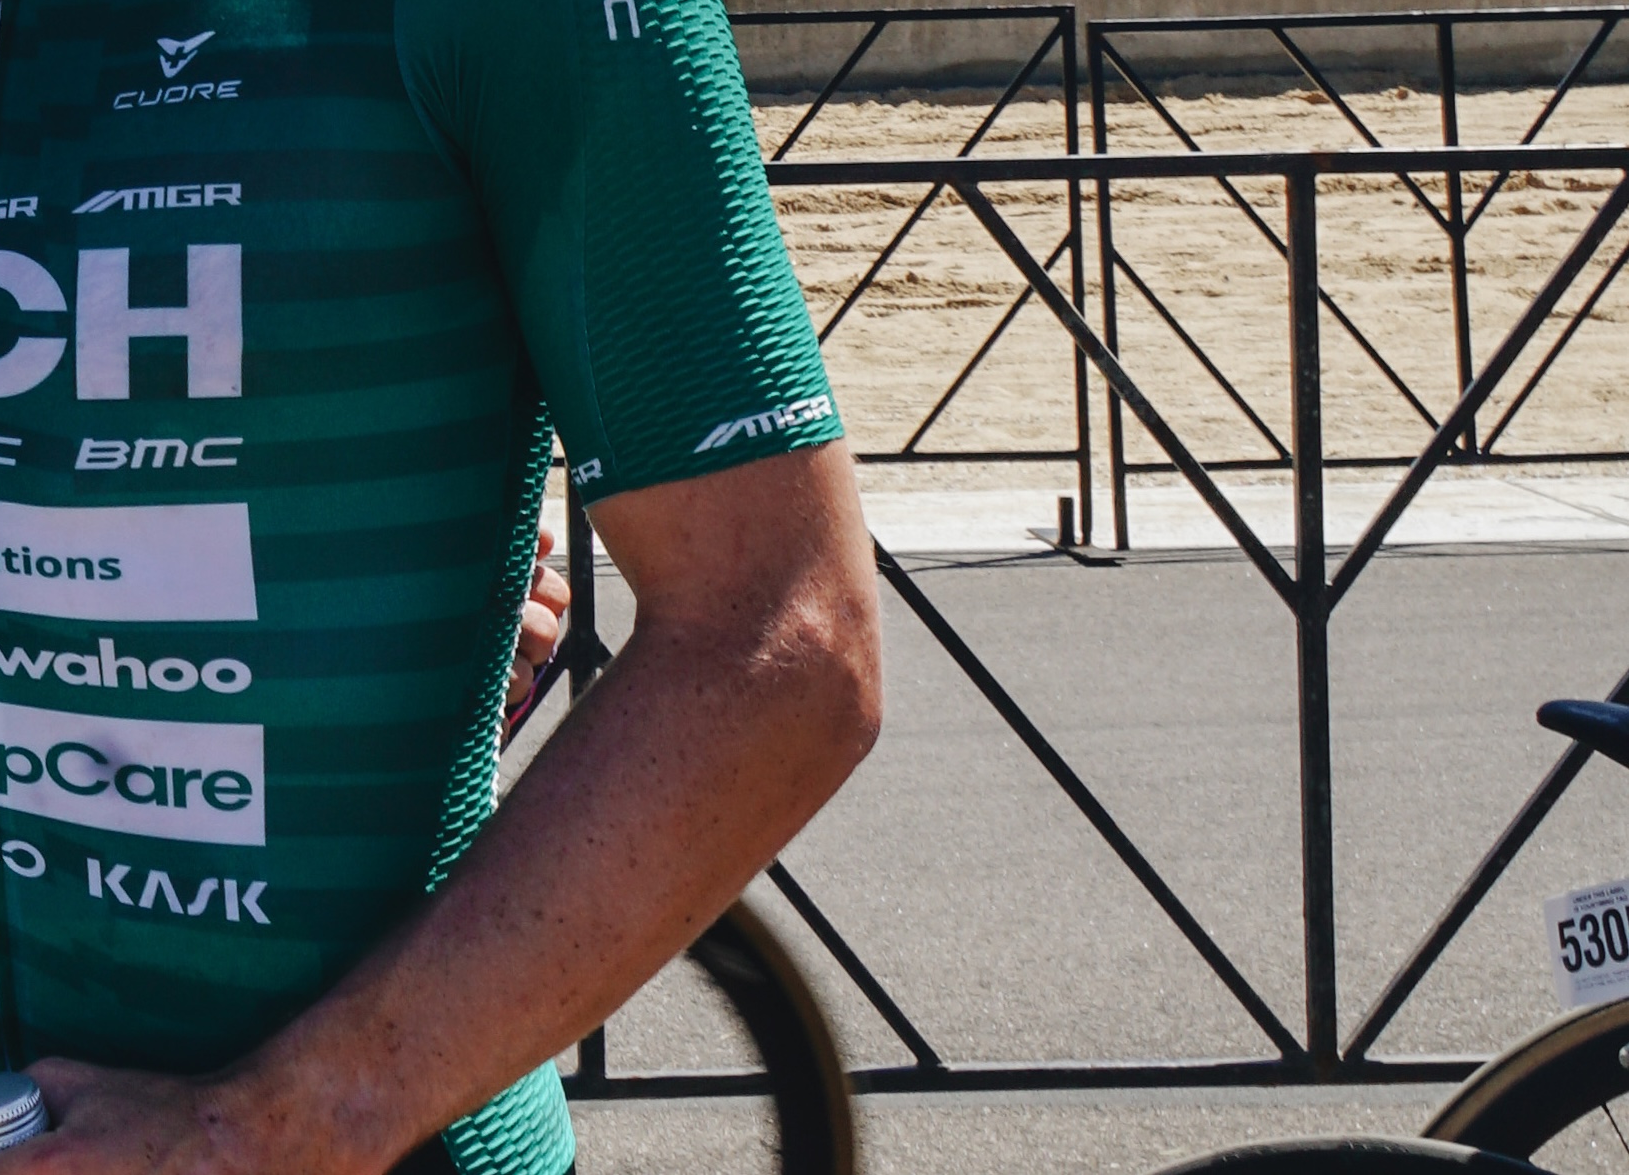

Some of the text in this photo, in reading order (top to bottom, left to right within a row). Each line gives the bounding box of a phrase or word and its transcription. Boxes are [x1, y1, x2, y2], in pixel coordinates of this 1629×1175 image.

[113, 80, 242, 109] CUORE
[74, 437, 243, 470] BMC
[87, 857, 272, 924] KASK
[1557, 905, 1629, 974] 530
